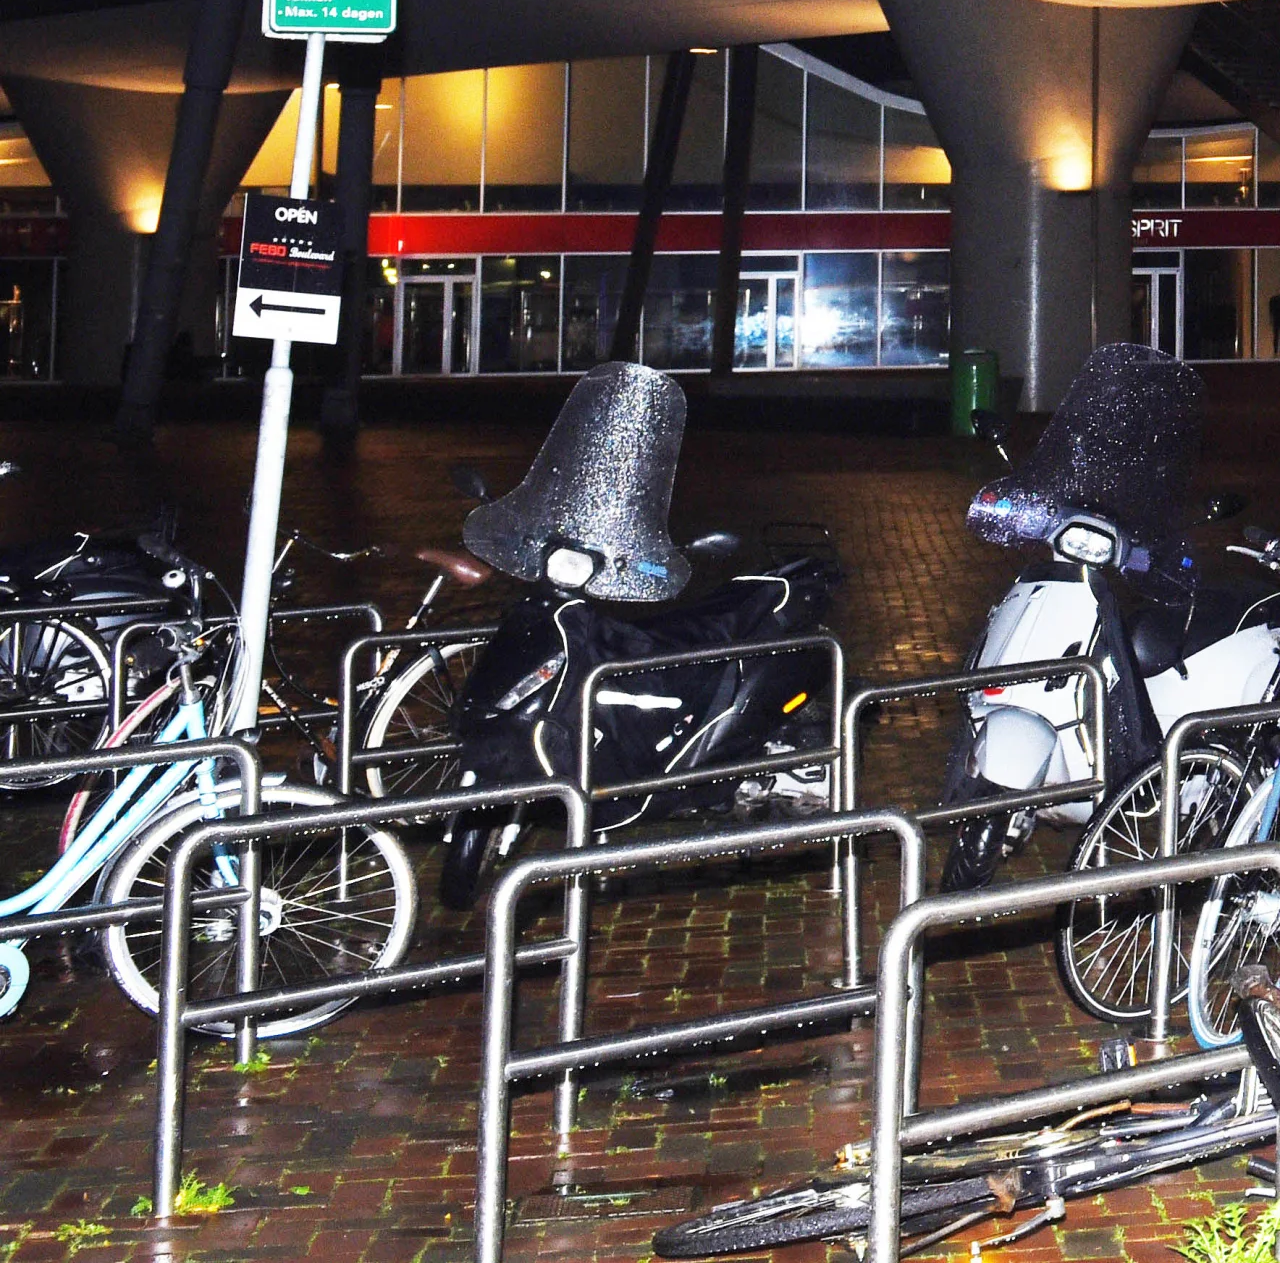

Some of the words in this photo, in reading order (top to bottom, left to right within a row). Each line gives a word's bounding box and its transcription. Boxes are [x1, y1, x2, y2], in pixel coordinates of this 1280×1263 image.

[285, 6, 317, 17] Max.
[322, 7, 338, 18] 14
[342, 7, 383, 21] dagen
[250, 243, 287, 257] FEBO
